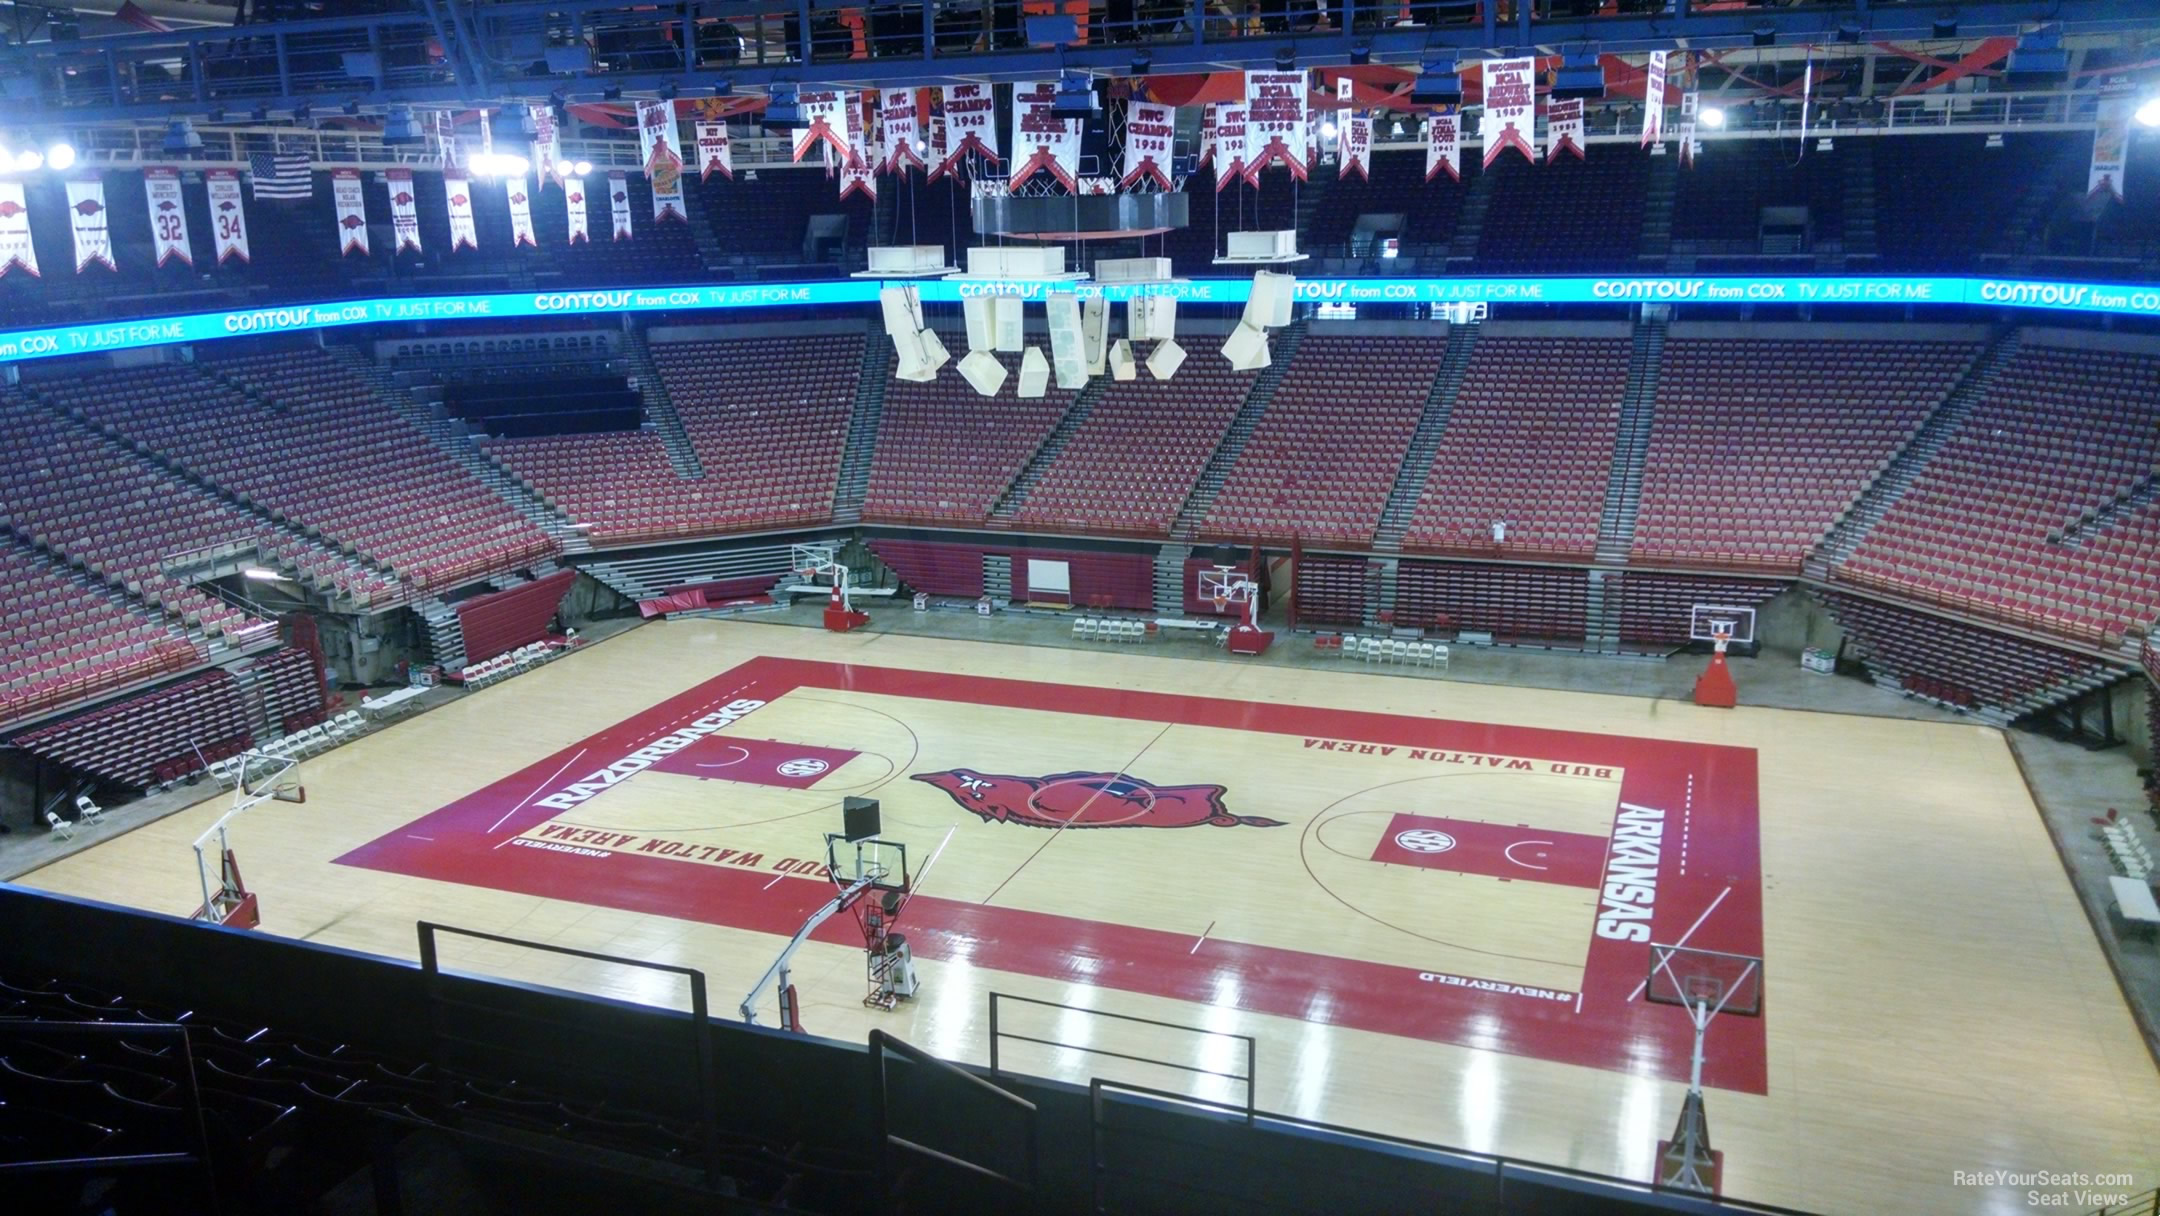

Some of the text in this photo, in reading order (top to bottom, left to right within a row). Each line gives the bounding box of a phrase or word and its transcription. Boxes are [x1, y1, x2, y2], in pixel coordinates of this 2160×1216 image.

[889, 93, 907, 106] SWC
[954, 85, 979, 98] SWC
[883, 105, 916, 121] CHAMPS
[945, 98, 992, 113] CHAMPS
[954, 115, 985, 127] 1942
[1139, 109, 1164, 122] SWC
[890, 122, 911, 134] 1944
[1128, 122, 1173, 138] CHAMPS
[1432, 126, 1456, 135] FINAL
[1026, 134, 1062, 143] 1992
[1432, 135, 1455, 144] FOUR
[158, 215, 183, 241] 32
[218, 214, 242, 240] 34
[637, 293, 666, 306] from
[669, 291, 700, 305] COX
[710, 290, 726, 303] TV
[728, 289, 759, 303] JUST
[761, 288, 789, 302] FOR
[791, 287, 811, 300] ME
[1075, 286, 1103, 298] COX
[1111, 286, 1127, 298] TV
[1191, 285, 1212, 298] ME
[1350, 284, 1381, 298] from
[1384, 284, 1417, 298] COX
[1428, 284, 1446, 298] TV
[1449, 284, 1484, 298] JUST
[1486, 284, 1519, 298] FOR
[1521, 284, 1544, 298] ME
[1708, 284, 1744, 298] from
[1747, 284, 1785, 298] COX
[1798, 283, 1819, 298] TV
[1821, 284, 1862, 298] JUST
[1865, 283, 1904, 298] FOR
[1905, 283, 1932, 298] ME
[2091, 290, 2126, 308] from
[314, 310, 340, 323] from
[342, 306, 368, 320] COX
[375, 304, 393, 317] TV
[398, 302, 430, 316] JUST
[434, 301, 466, 314] FOR
[469, 300, 491, 313] ME
[20, 335, 59, 354] COX
[69, 332, 89, 348] TV
[92, 328, 126, 346] JUST
[129, 325, 160, 342] FOR
[163, 321, 185, 338] ME
[532, 698, 767, 810] RAZORBACKS
[1303, 738, 1613, 779] BUD WALTON ARENA
[539, 824, 638, 848] ARENA
[512, 838, 612, 858] #NEVERYIELD
[637, 838, 764, 867] WALTON
[1595, 802, 1665, 943] ARKANSAS
[1419, 972, 1573, 1002] #NEVERYIELD
